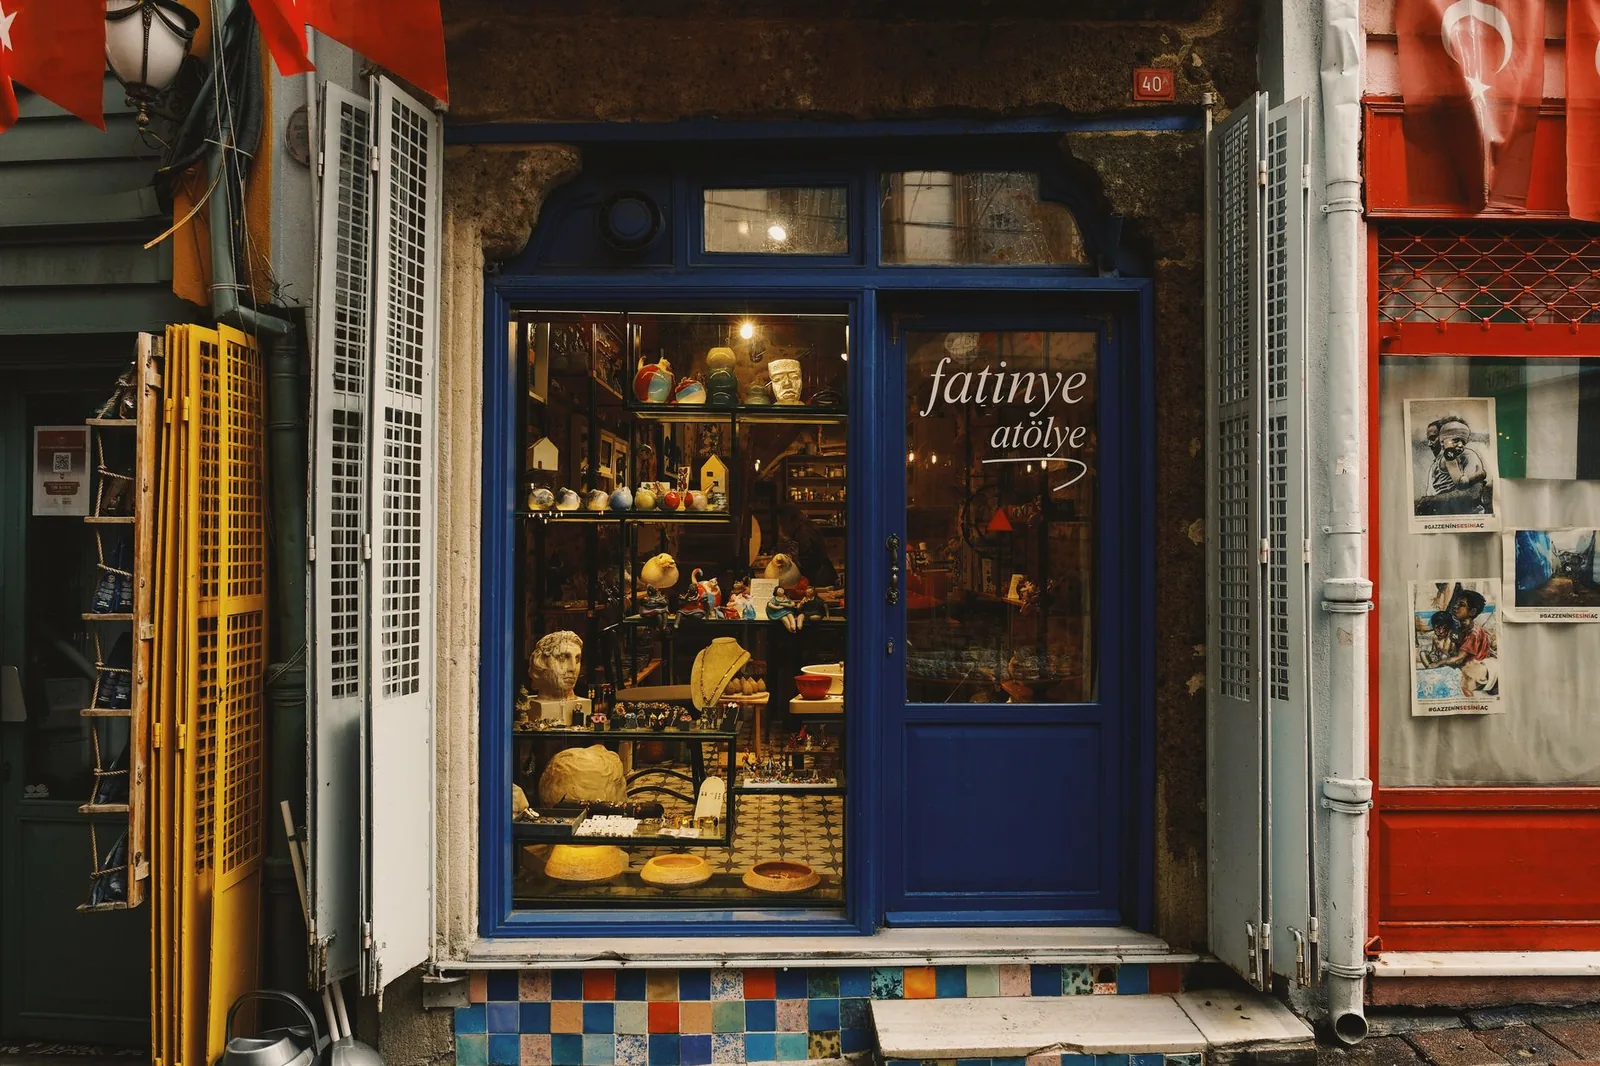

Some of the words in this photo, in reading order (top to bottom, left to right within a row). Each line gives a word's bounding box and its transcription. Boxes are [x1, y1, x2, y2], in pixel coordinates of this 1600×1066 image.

[1142, 76, 1162, 92] 40
[919, 357, 1087, 417] fatinye
[990, 416, 1087, 457] atölye
